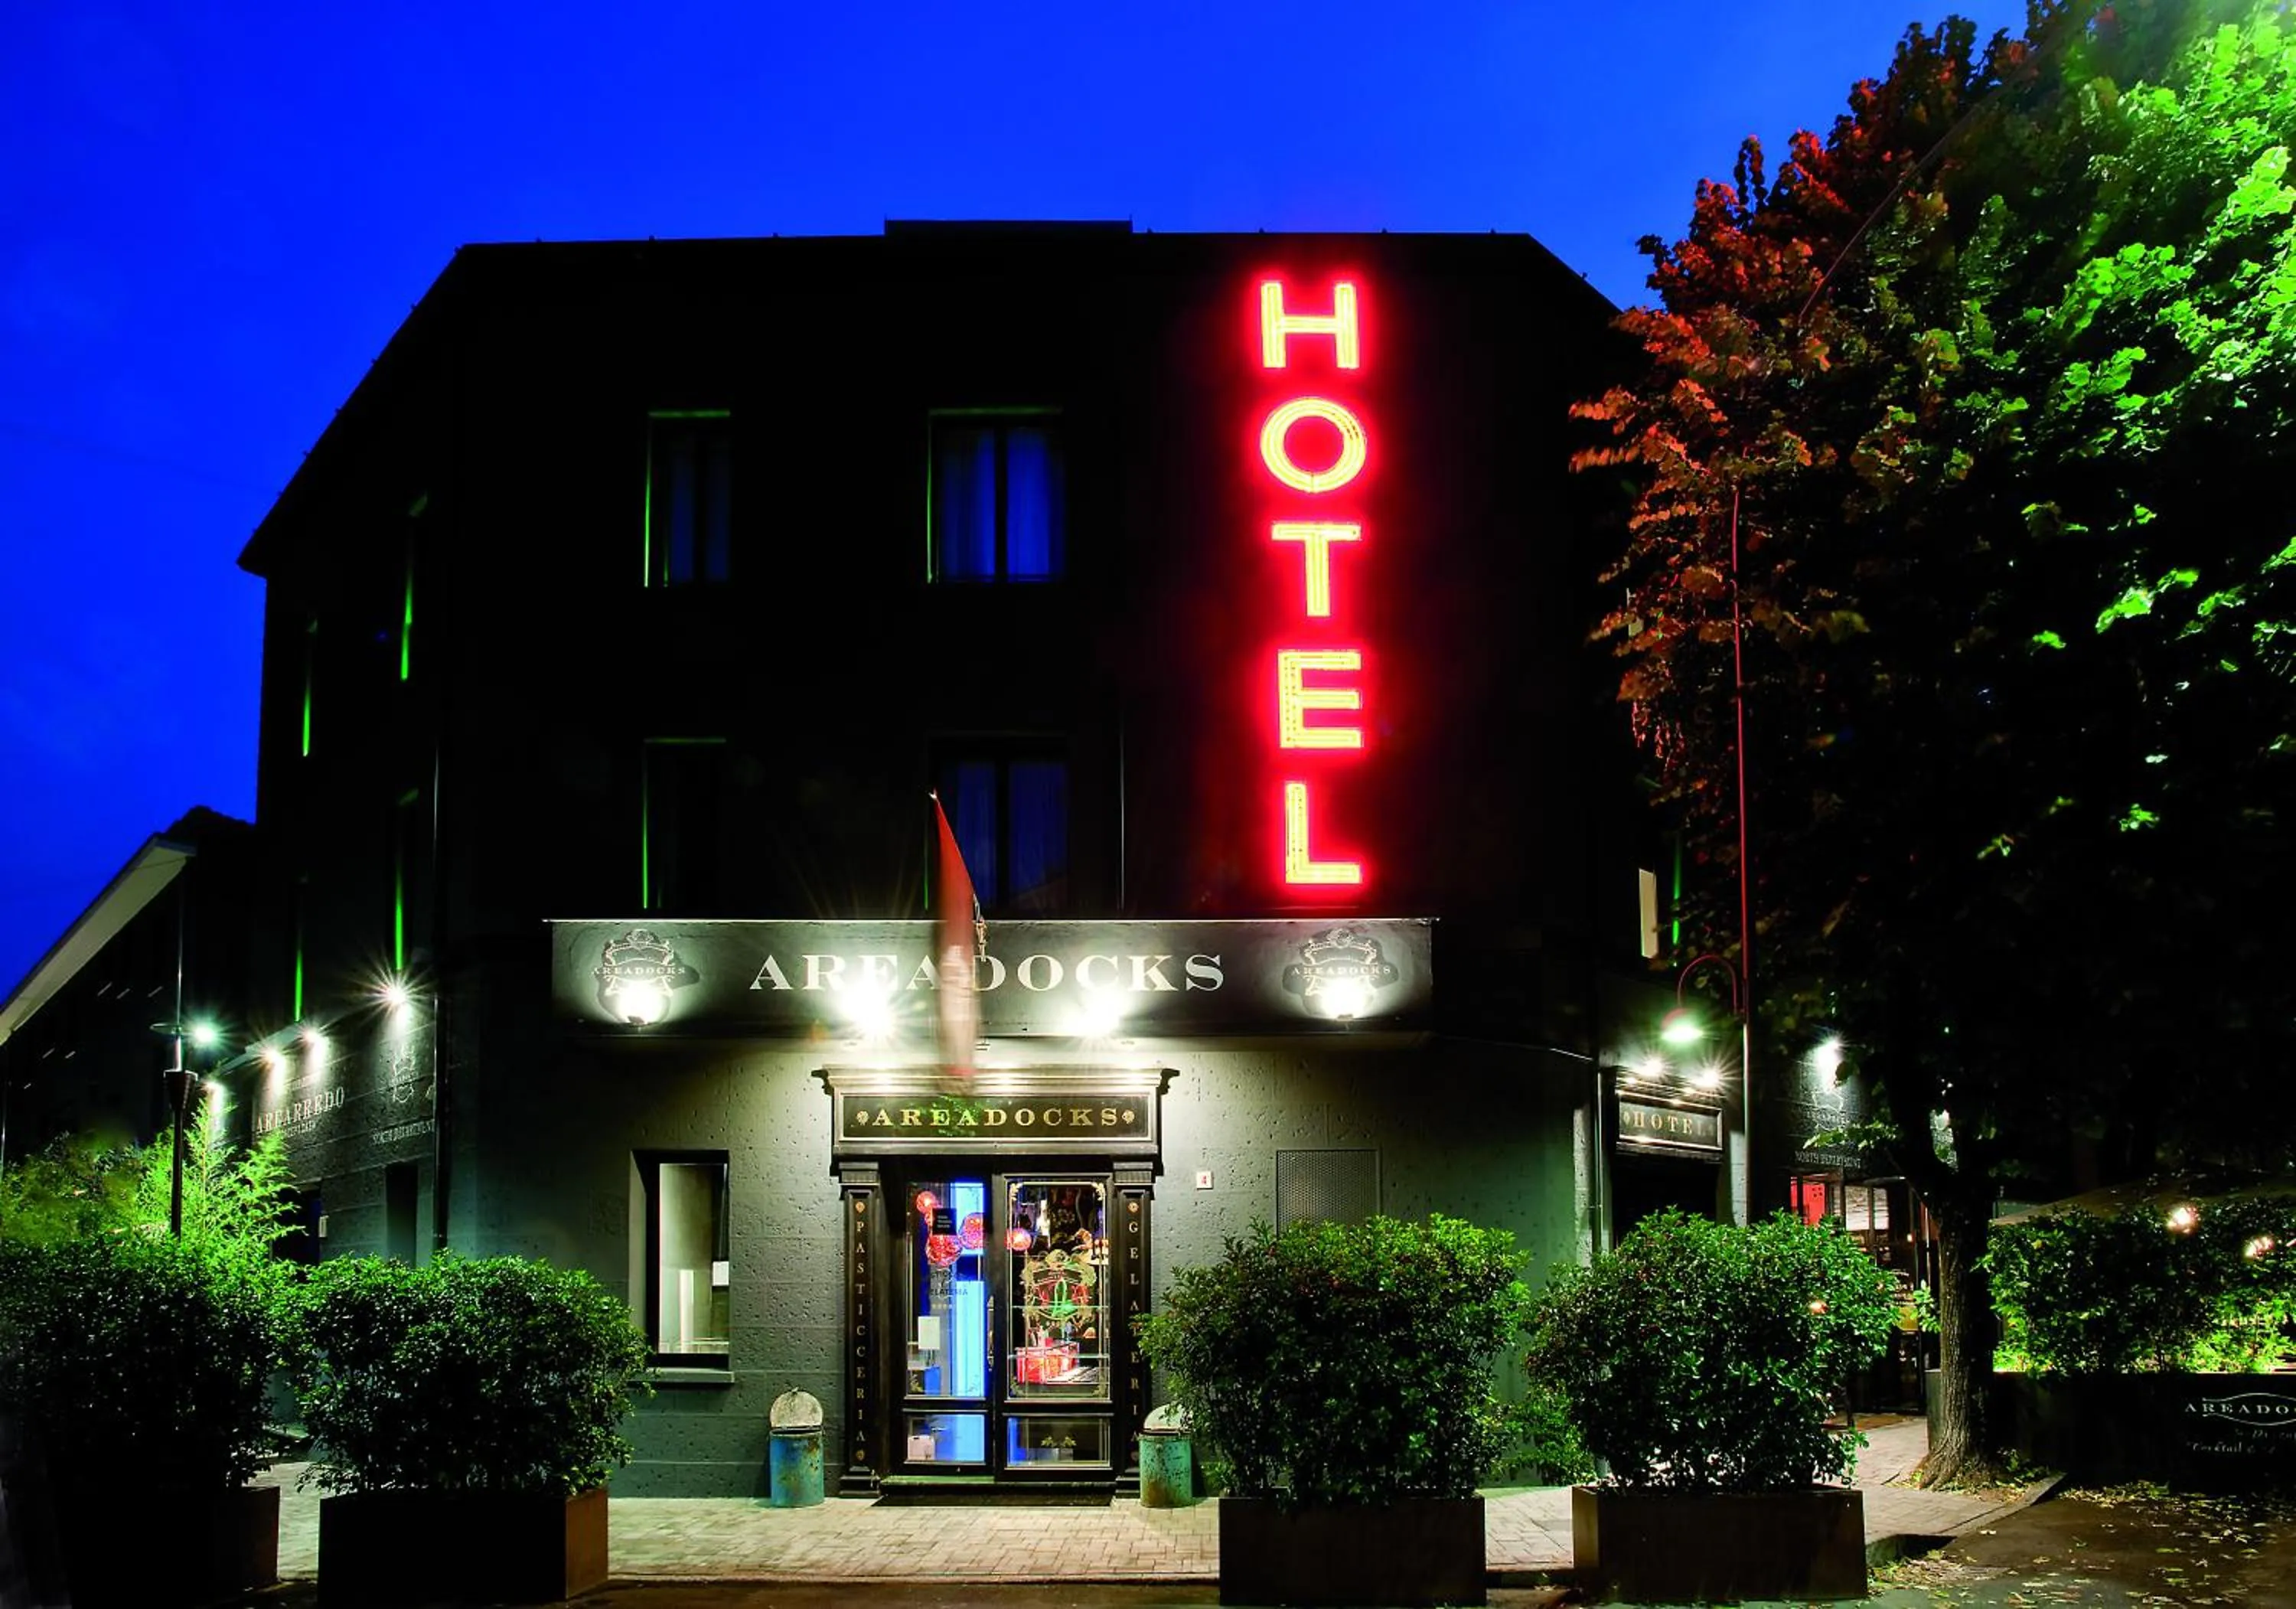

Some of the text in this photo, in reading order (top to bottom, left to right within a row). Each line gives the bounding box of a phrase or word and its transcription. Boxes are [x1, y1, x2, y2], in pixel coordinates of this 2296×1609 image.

[1260, 281, 1367, 885] HOTEL
[590, 967, 686, 975] AREADOCKS
[749, 955, 1225, 991] AREADOCKS
[1291, 966, 1391, 975] AREADOCKS
[872, 1109, 1119, 1126] AREADOCKS
[855, 1221, 866, 1442] PASTICCERIA
[2183, 1402, 2296, 1415] AREADO
